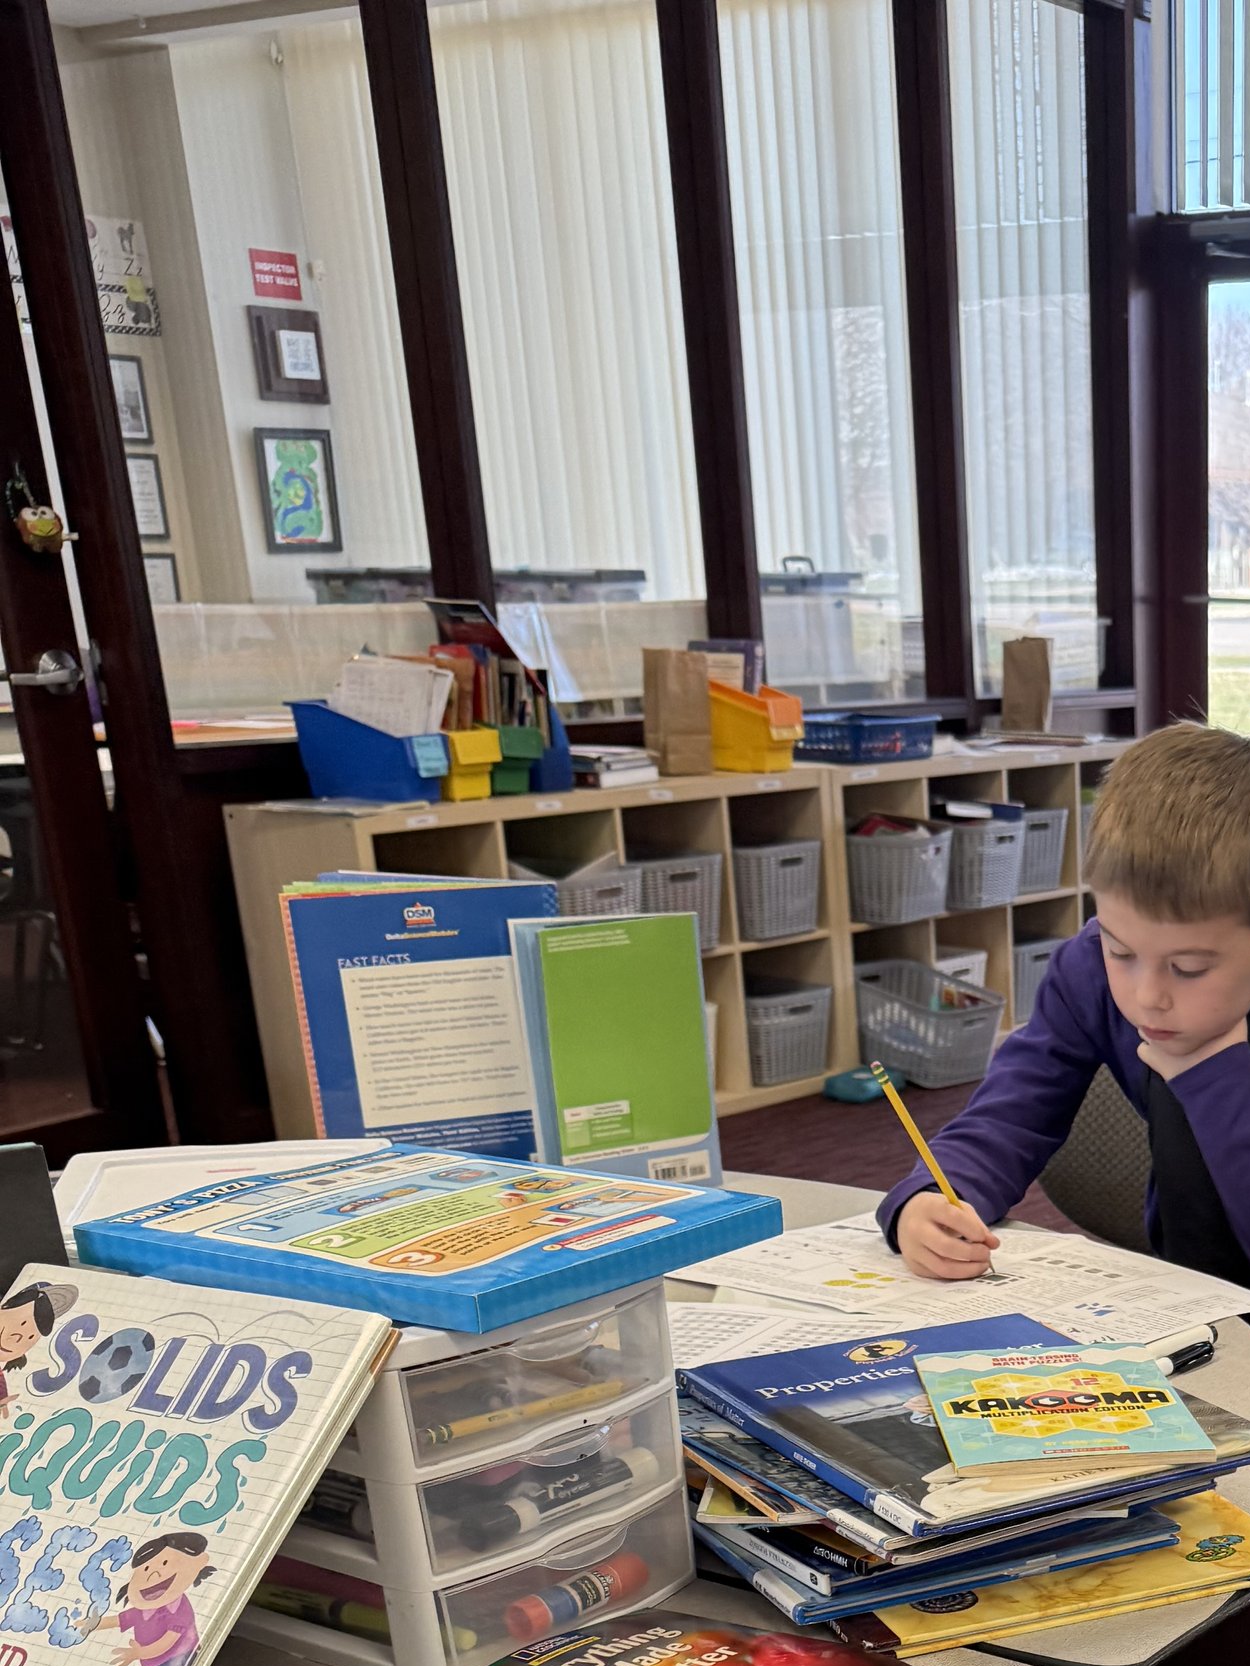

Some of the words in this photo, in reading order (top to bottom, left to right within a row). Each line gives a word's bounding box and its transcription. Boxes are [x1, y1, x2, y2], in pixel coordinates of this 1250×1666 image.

[406, 908, 433, 919] DSM
[337, 956, 368, 969] FAST
[372, 953, 411, 966] FACTS
[108, 1197, 201, 1225] TONY'S
[192, 1180, 268, 1205] PIZZA
[237, 1221, 276, 1233] 1
[308, 1230, 367, 1250] 2
[387, 1249, 443, 1268] 3
[991, 1353, 1079, 1362] BRAIN-TEASING
[26, 1314, 312, 1434] SOLIDS
[1070, 1377, 1101, 1387] 12
[755, 1366, 916, 1400] Properties
[950, 1389, 1170, 1415] KAKOOMA
[980, 1407, 1090, 1419] MULTIPLICATION
[1094, 1404, 1146, 1414] EDITION
